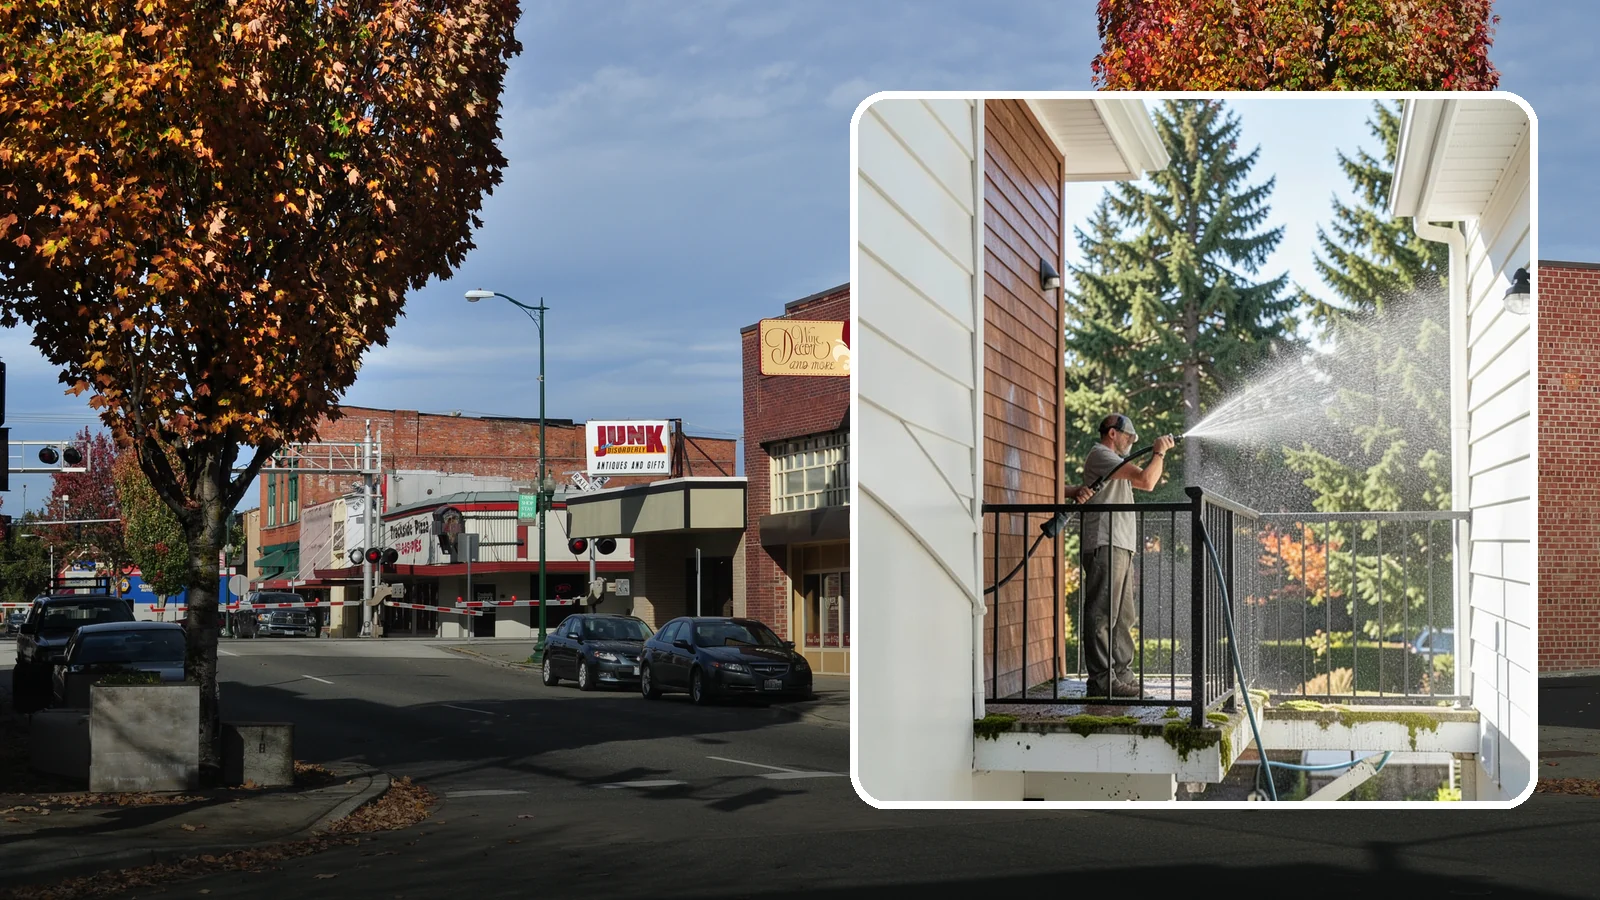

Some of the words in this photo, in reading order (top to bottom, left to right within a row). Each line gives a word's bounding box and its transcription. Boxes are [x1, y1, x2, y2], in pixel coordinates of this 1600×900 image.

[595, 425, 665, 457] JUNK
[607, 446, 646, 454] DISORDERLY
[597, 461, 628, 470] ANTIQUES
[631, 461, 644, 470] AND
[646, 460, 665, 469] GIFTS
[414, 519, 429, 535] Pizza
